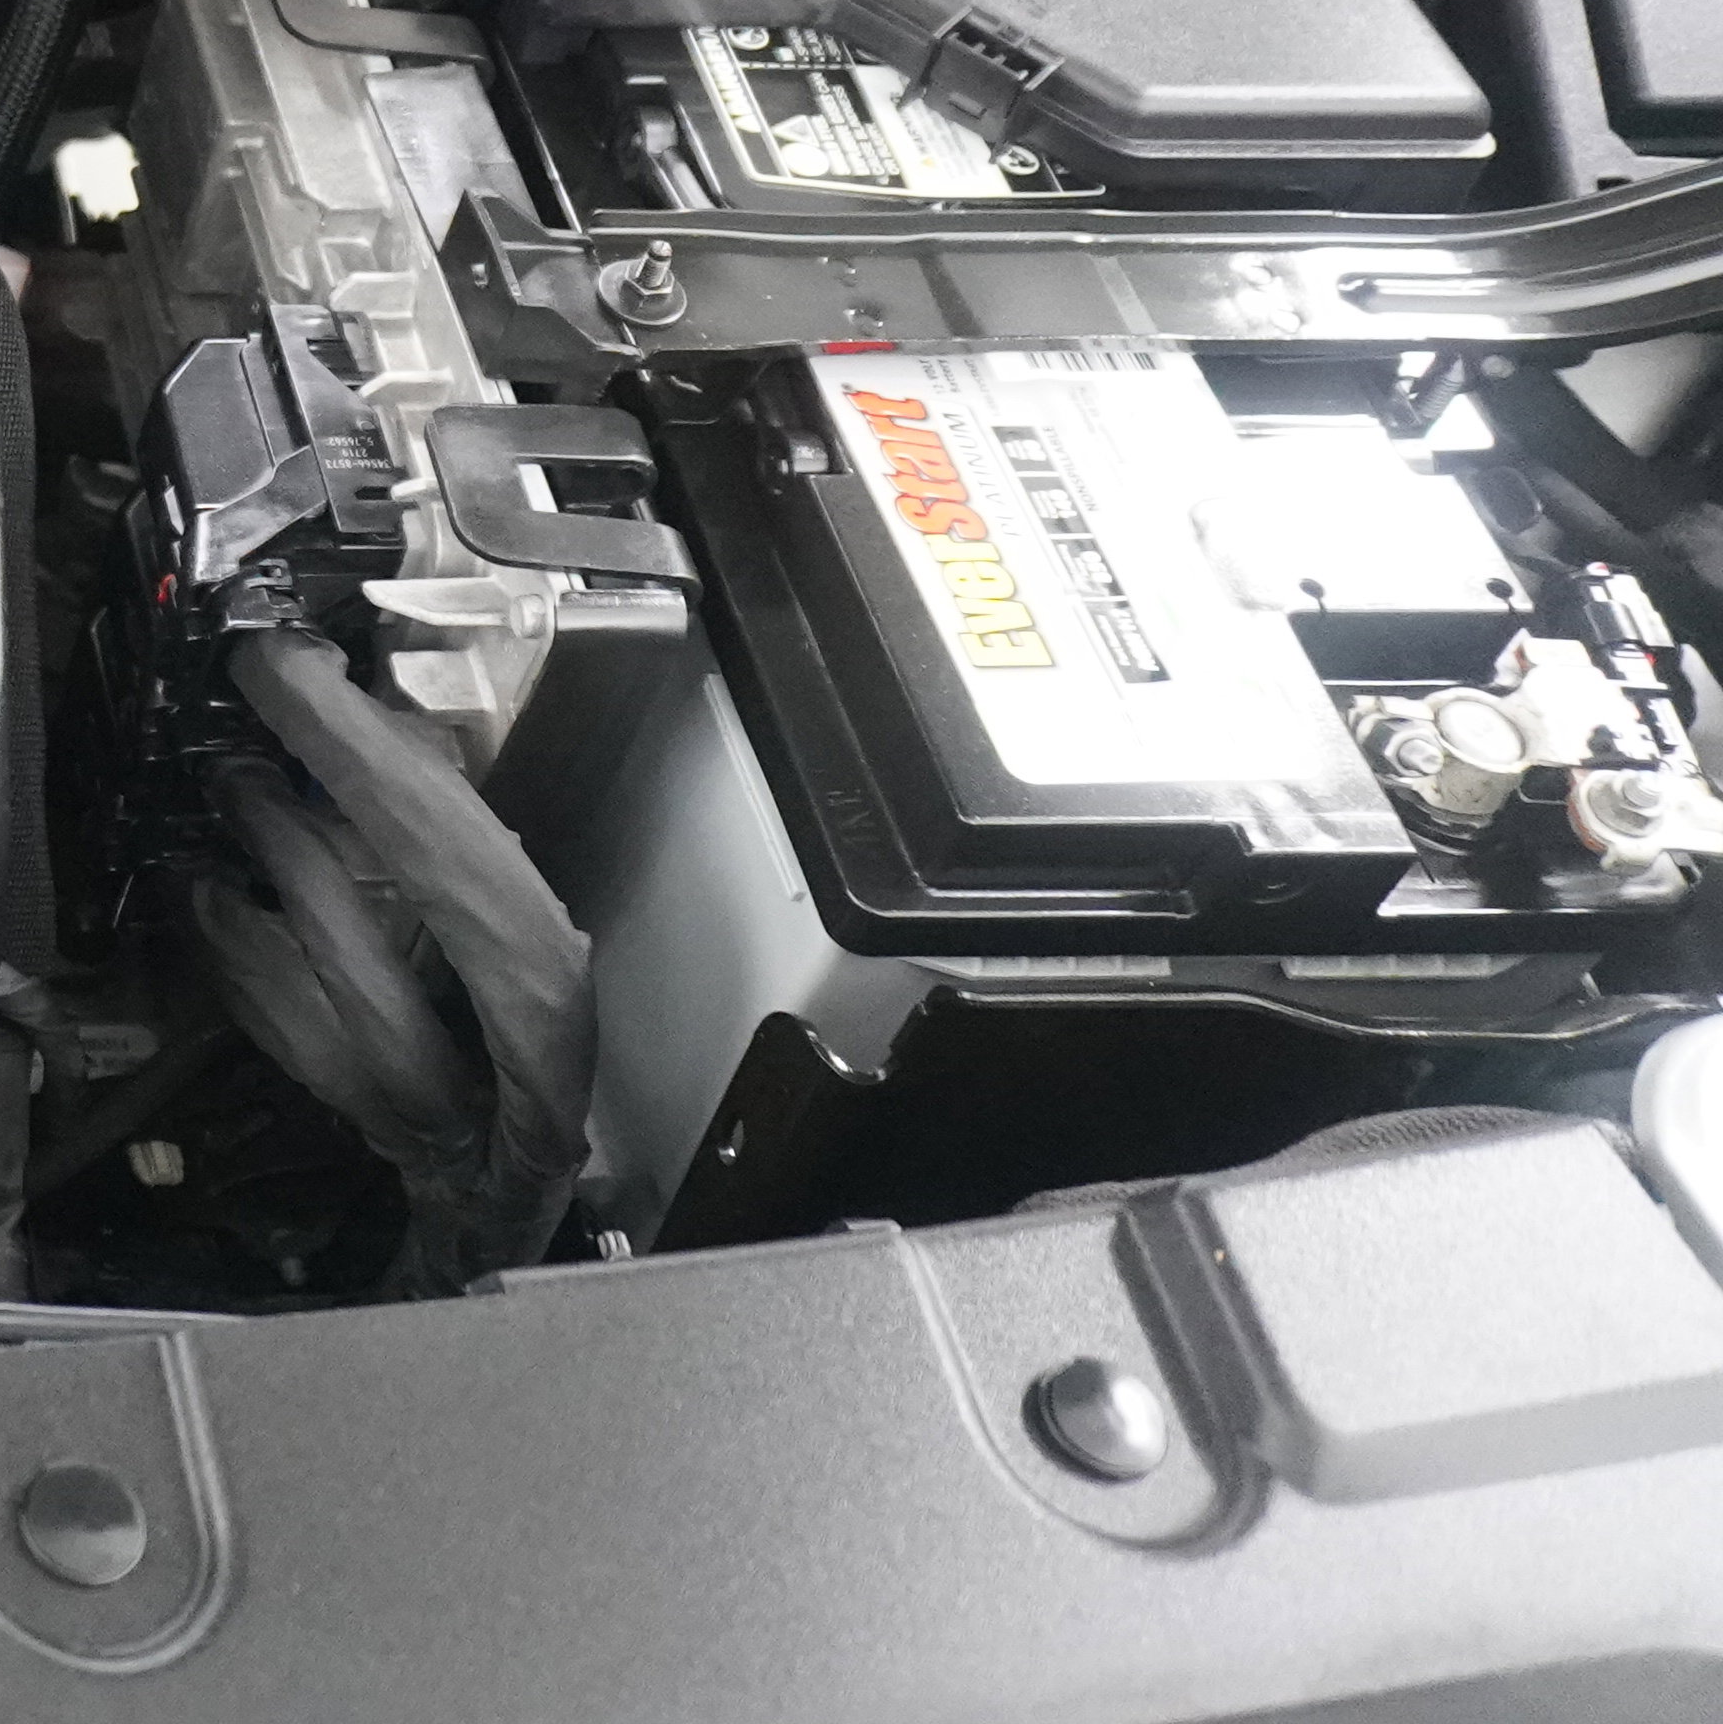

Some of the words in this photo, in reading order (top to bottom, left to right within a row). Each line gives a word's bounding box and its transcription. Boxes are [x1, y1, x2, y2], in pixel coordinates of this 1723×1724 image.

[843, 390, 1055, 668] EverStart
[943, 412, 1020, 536] PLATINUM
[1045, 427, 1098, 512] NONSPILLABLE
